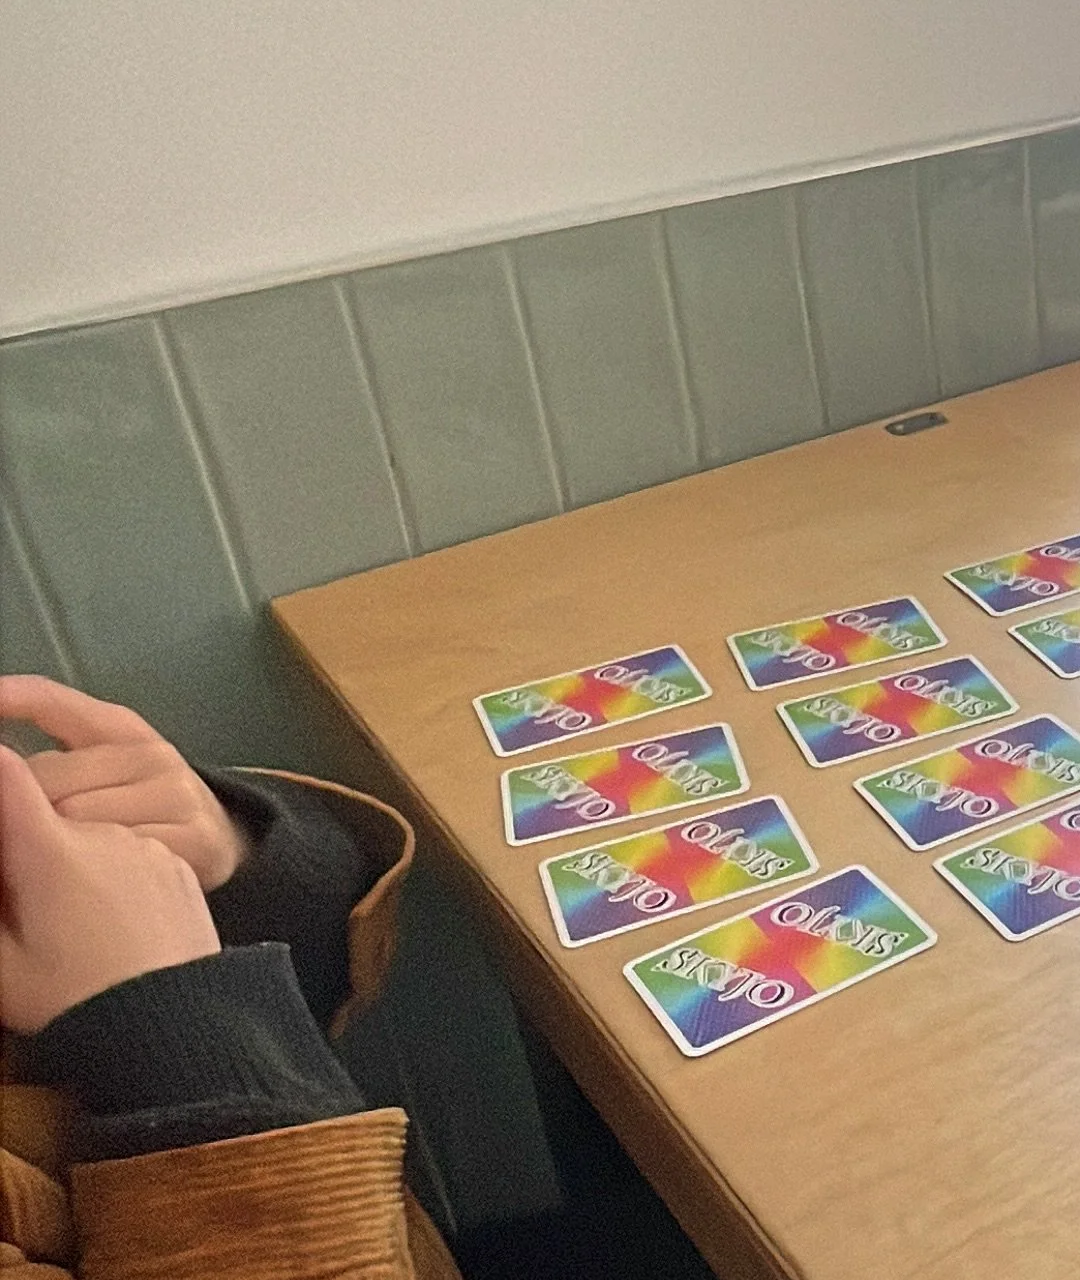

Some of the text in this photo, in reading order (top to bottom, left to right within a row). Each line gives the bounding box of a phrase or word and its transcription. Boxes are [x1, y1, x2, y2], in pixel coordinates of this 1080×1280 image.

[876, 770, 1000, 819] SKYJO
[680, 821, 794, 878] SKYJO
[562, 852, 677, 913] SKYJO
[770, 901, 910, 958] SKYJO
[651, 947, 795, 1008] SKYJO
